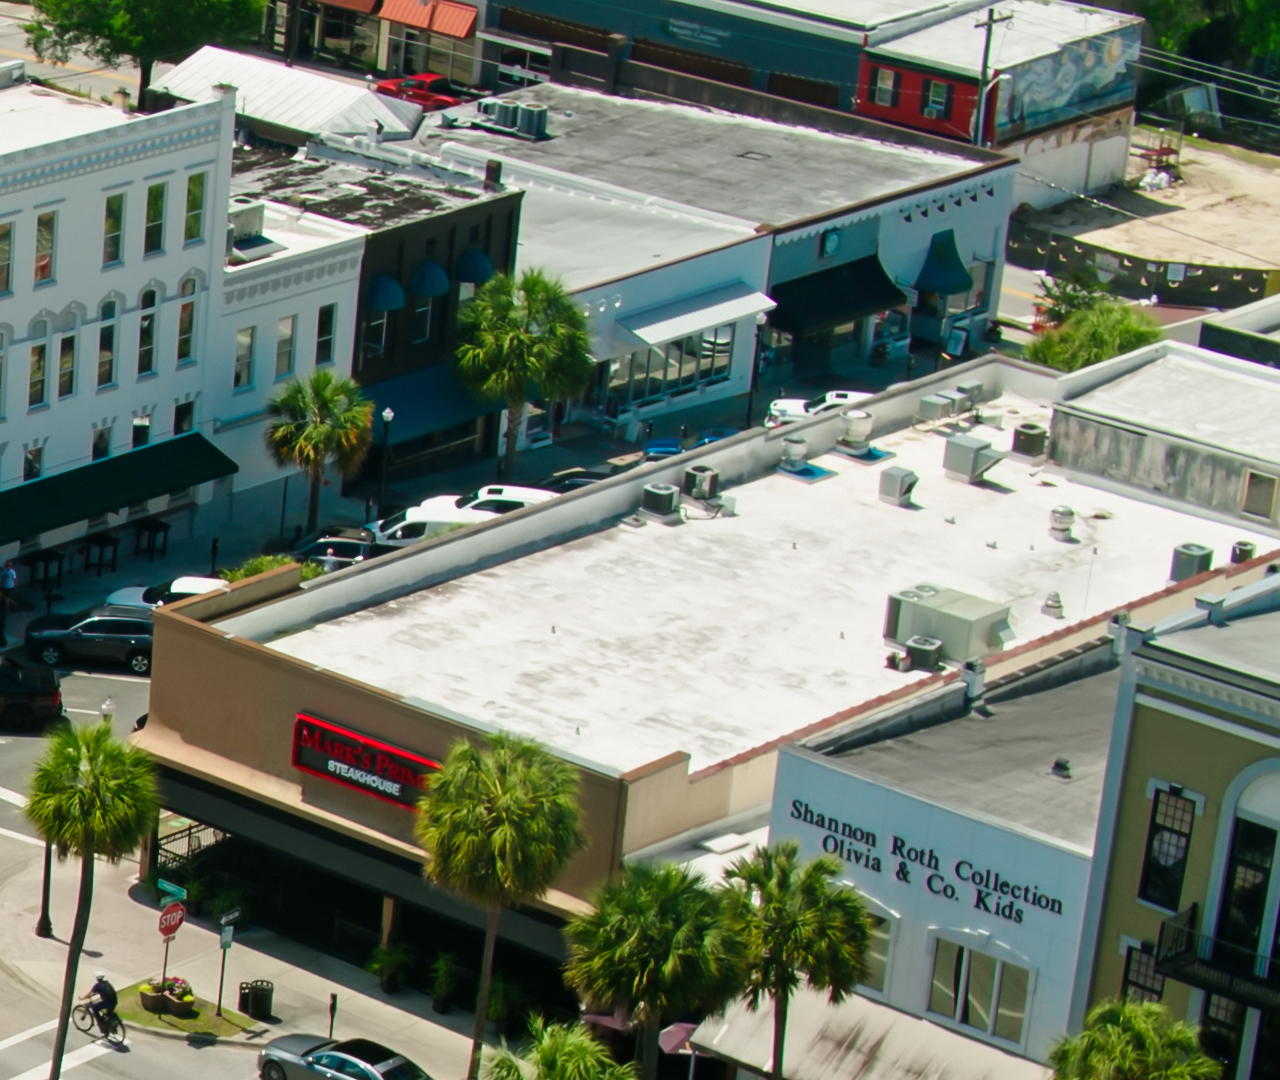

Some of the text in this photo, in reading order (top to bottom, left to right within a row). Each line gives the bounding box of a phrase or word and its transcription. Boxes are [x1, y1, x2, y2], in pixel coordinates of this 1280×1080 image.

[327, 759, 402, 797] STEAKHOUSE
[790, 799, 1063, 916] Shannon Roth Collection
[821, 834, 1024, 924] Olivia & Co. Kids
[160, 910, 183, 929] STOP
